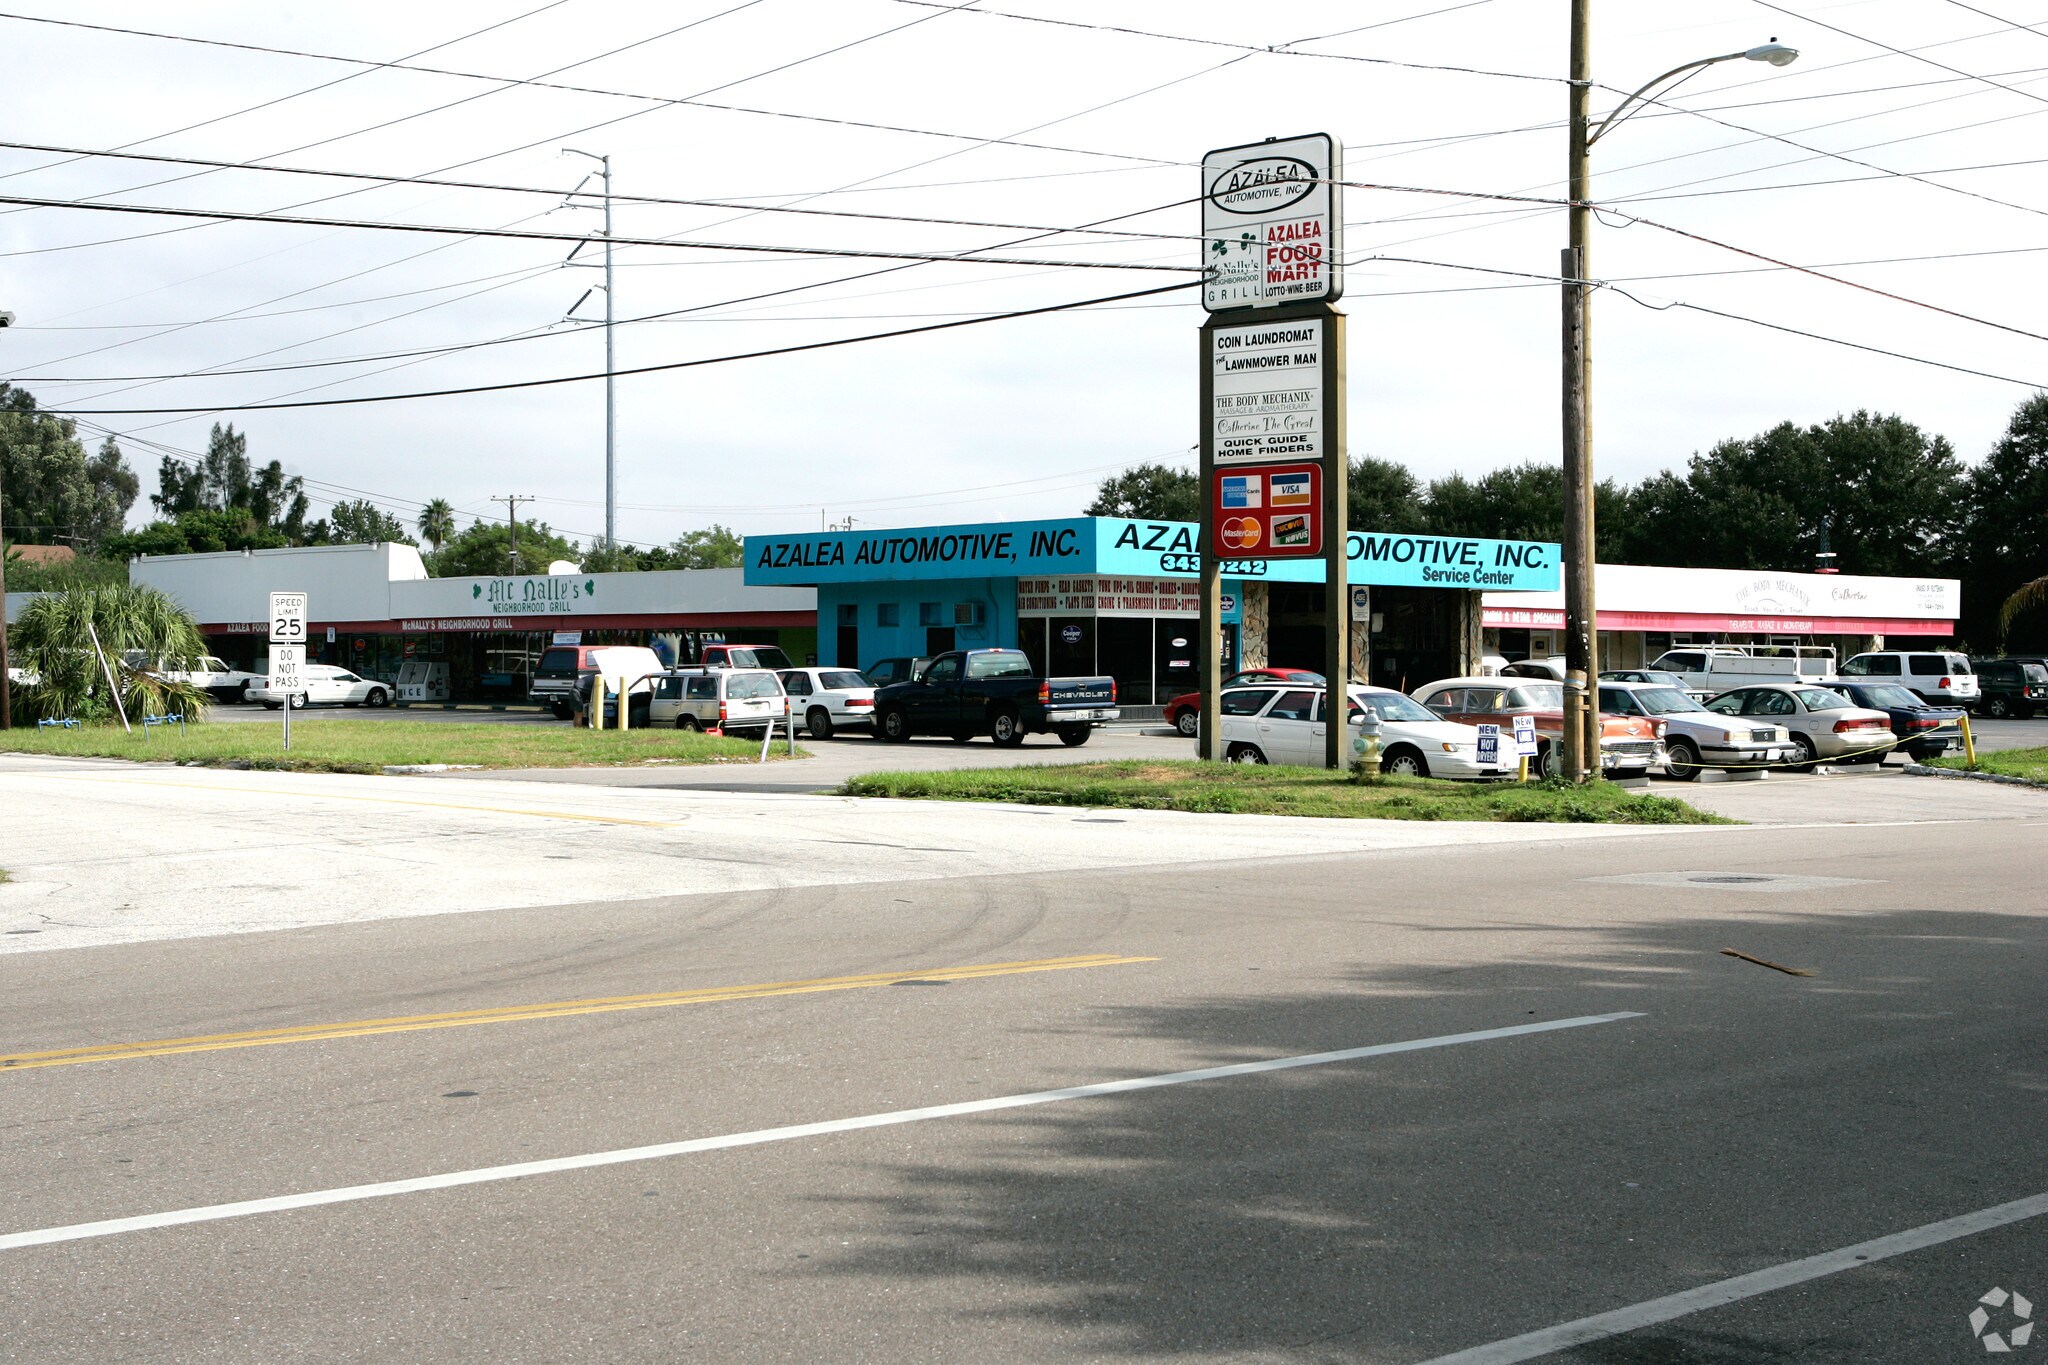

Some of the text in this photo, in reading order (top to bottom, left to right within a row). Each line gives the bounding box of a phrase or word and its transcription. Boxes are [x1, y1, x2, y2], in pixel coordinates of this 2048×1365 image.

[1228, 164, 1299, 190] AZALEA
[1224, 184, 1304, 204] AUTOMOTIVE, INC.
[1268, 220, 1321, 242] AZALEA
[1267, 243, 1322, 265] FOOD
[1267, 262, 1321, 283] MART
[1210, 275, 1259, 287] NEIGHBORHOOD
[1218, 329, 1314, 349] COIN LAUNDROMAT
[1216, 353, 1317, 371] THE LAWNMOWER MAN
[1216, 391, 1311, 408] THE BODY MECHANIX
[1220, 407, 1247, 415] MASSAGE
[1256, 402, 1309, 413] AROMATHERAPY
[1218, 414, 1314, 434] Catherine The Great
[1224, 435, 1308, 447] QUICK GUIDE
[1218, 444, 1314, 457] HOME FINDERS
[1281, 485, 1300, 494] VISA
[1275, 518, 1304, 534] DISCOVER
[1223, 529, 1259, 537] MasterCard
[1285, 530, 1309, 544] NOVUS
[757, 528, 1081, 568] AZALEA AUTOMOTIVE, INC.
[1495, 544, 1549, 569] INC.
[1422, 565, 1514, 585] Service Center
[523, 579, 579, 602] Nally's
[275, 598, 302, 607] SPEED
[493, 601, 572, 613] NEIGHBORHOOD GRILL
[278, 608, 298, 616] LIMIT
[227, 622, 269, 633] AZALEA FOOD
[275, 618, 301, 636] 25
[402, 618, 513, 631] McNALLY'S NEIGHBORHOOD GRILL
[280, 649, 292, 661] DO
[278, 663, 296, 674] NOT
[275, 676, 299, 687] PASS
[403, 688, 421, 696] ICE
[1052, 691, 1109, 699] CHEVROLET
[1515, 717, 1532, 726] NEW
[1479, 725, 1498, 735] NEW
[1480, 739, 1494, 750] HOT
